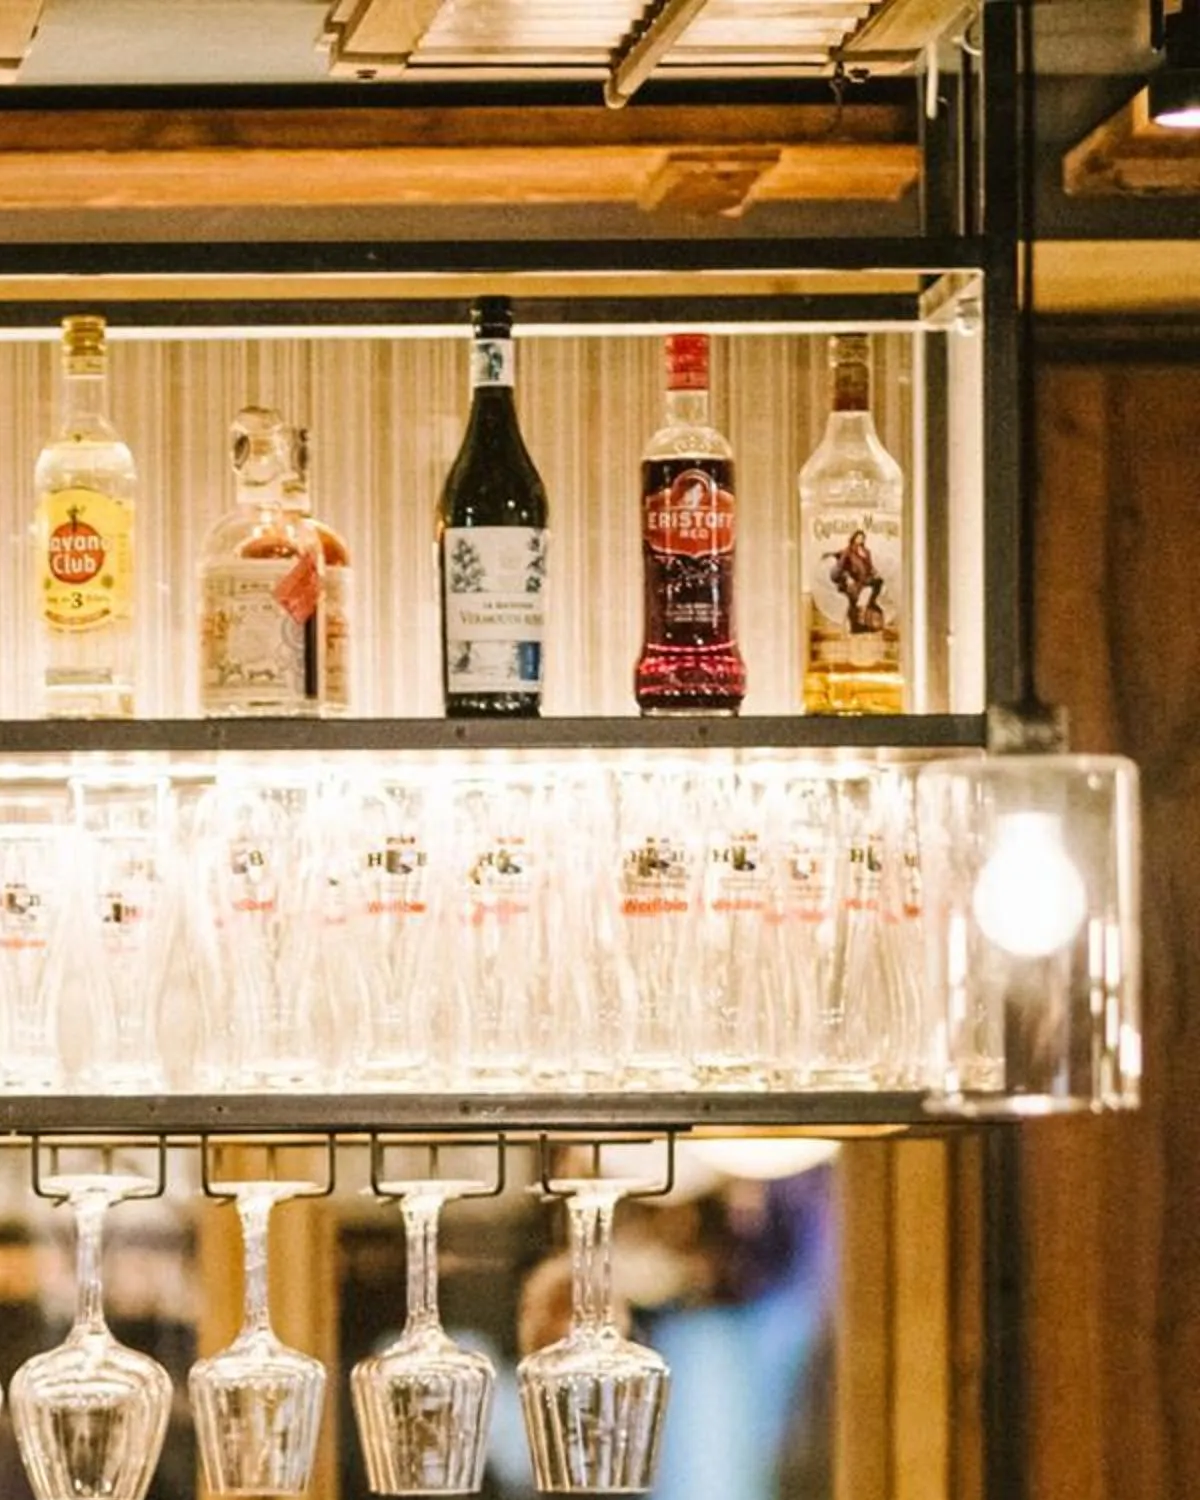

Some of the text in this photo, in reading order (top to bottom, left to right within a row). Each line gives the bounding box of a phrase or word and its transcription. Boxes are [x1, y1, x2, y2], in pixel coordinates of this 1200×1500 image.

[49, 534, 111, 552] avana
[52, 551, 97, 575] Club
[70, 591, 83, 609] 3
